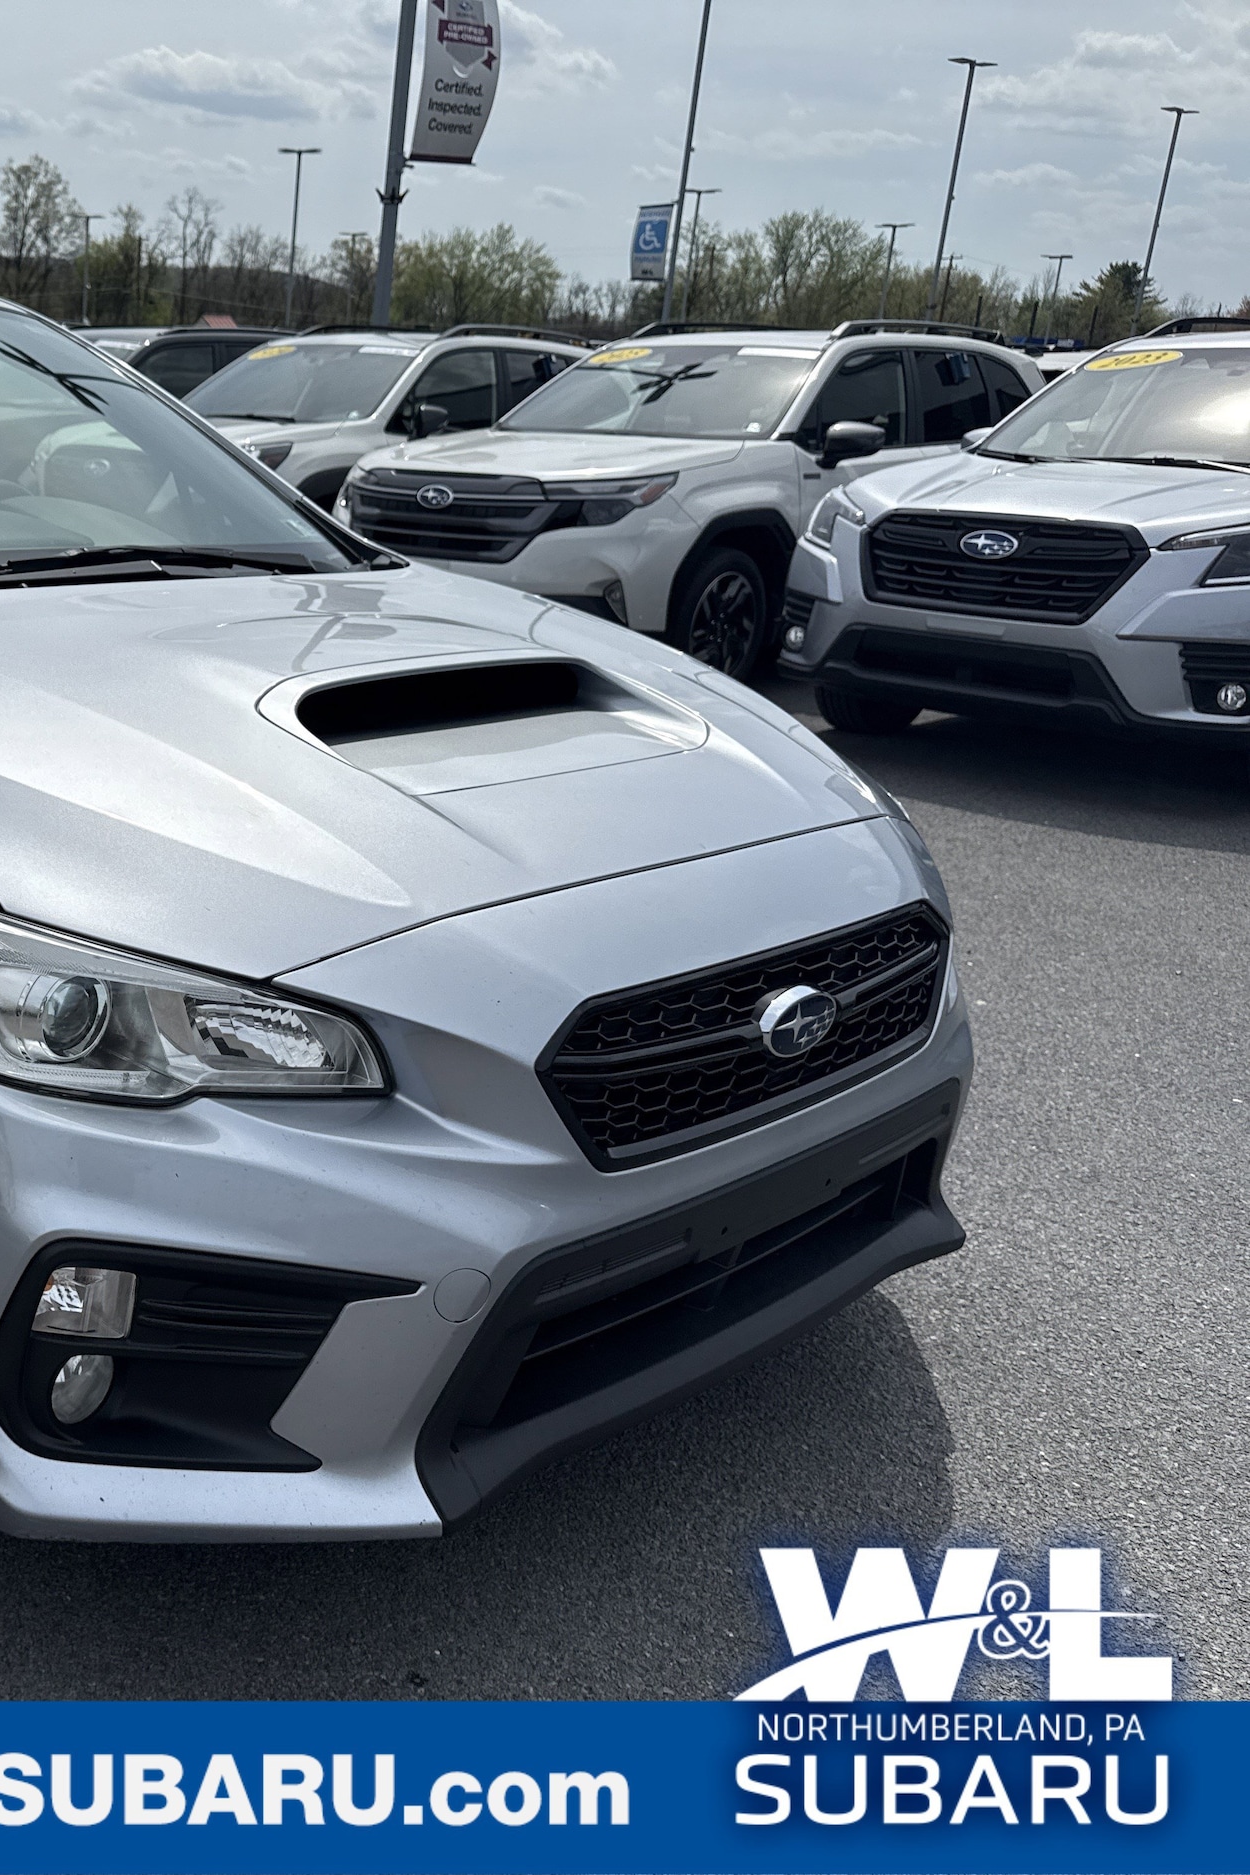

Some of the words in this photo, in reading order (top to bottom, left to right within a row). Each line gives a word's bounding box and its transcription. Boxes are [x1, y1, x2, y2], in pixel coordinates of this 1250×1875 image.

[443, 30, 489, 45] PRE-OWNED
[447, 22, 485, 36] CERTIFIED
[434, 78, 484, 97] Certified.
[428, 97, 482, 117] Inspected.
